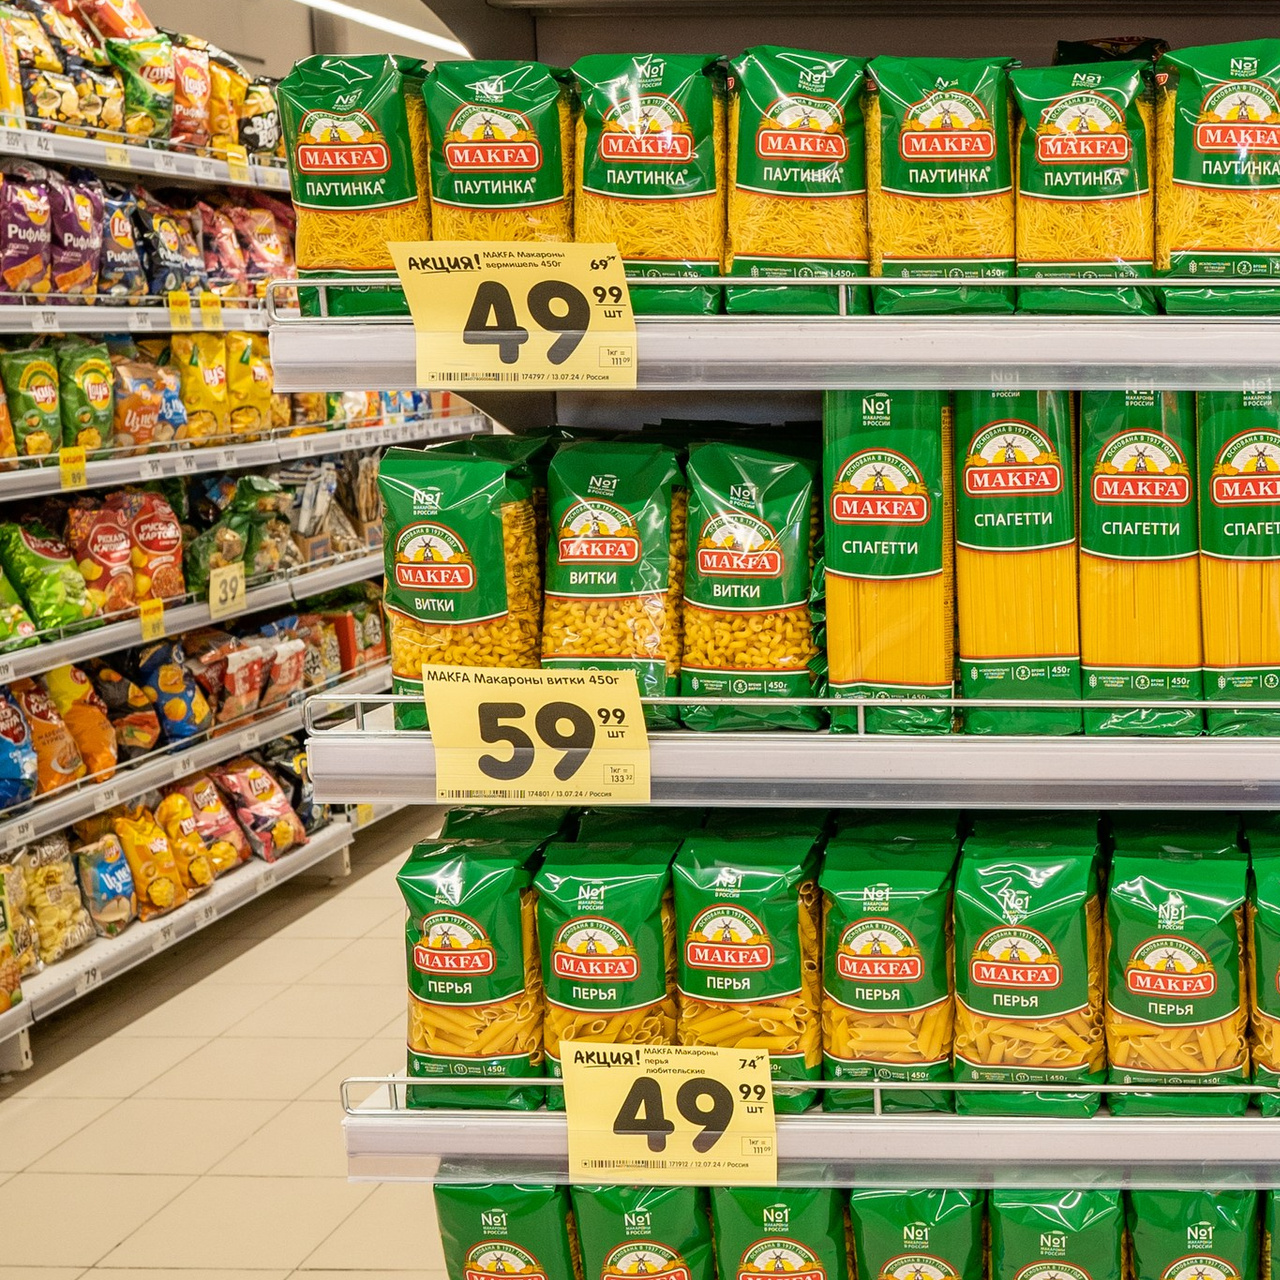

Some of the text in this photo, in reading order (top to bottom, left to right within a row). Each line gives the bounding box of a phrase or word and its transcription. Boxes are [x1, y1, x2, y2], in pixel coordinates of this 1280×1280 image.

[909, 137, 986, 154] MAKFA
[452, 148, 528, 166] MAKFA
[408, 254, 482, 273] АКЦИЯ!
[463, 280, 622, 365] 49 99
[604, 310, 622, 318] шт
[977, 427, 1006, 449] ОСНОВАНА
[1015, 427, 1029, 436] 1937
[1030, 435, 1044, 448] ГОДУ
[973, 471, 1050, 488] MAKFA
[842, 501, 918, 516] MAKFA
[975, 513, 1052, 527] СПАГЕТТИ
[842, 541, 918, 554] СПАГЕТТИ
[401, 566, 464, 584] MAKFA
[570, 572, 617, 585] ВИТКИ
[713, 584, 760, 598] ВИТКИ
[415, 597, 454, 612] ВИТКИ
[427, 671, 470, 683] MAKFA
[474, 674, 543, 686] Макароны
[589, 675, 619, 685] 450г
[478, 701, 625, 781] 59 99
[608, 730, 625, 738] шт
[694, 947, 763, 964] MAKFA
[706, 976, 750, 991] ПЕРЬЯ
[574, 1050, 640, 1068] АКЦИЯ!
[613, 1077, 765, 1154] 49 99
